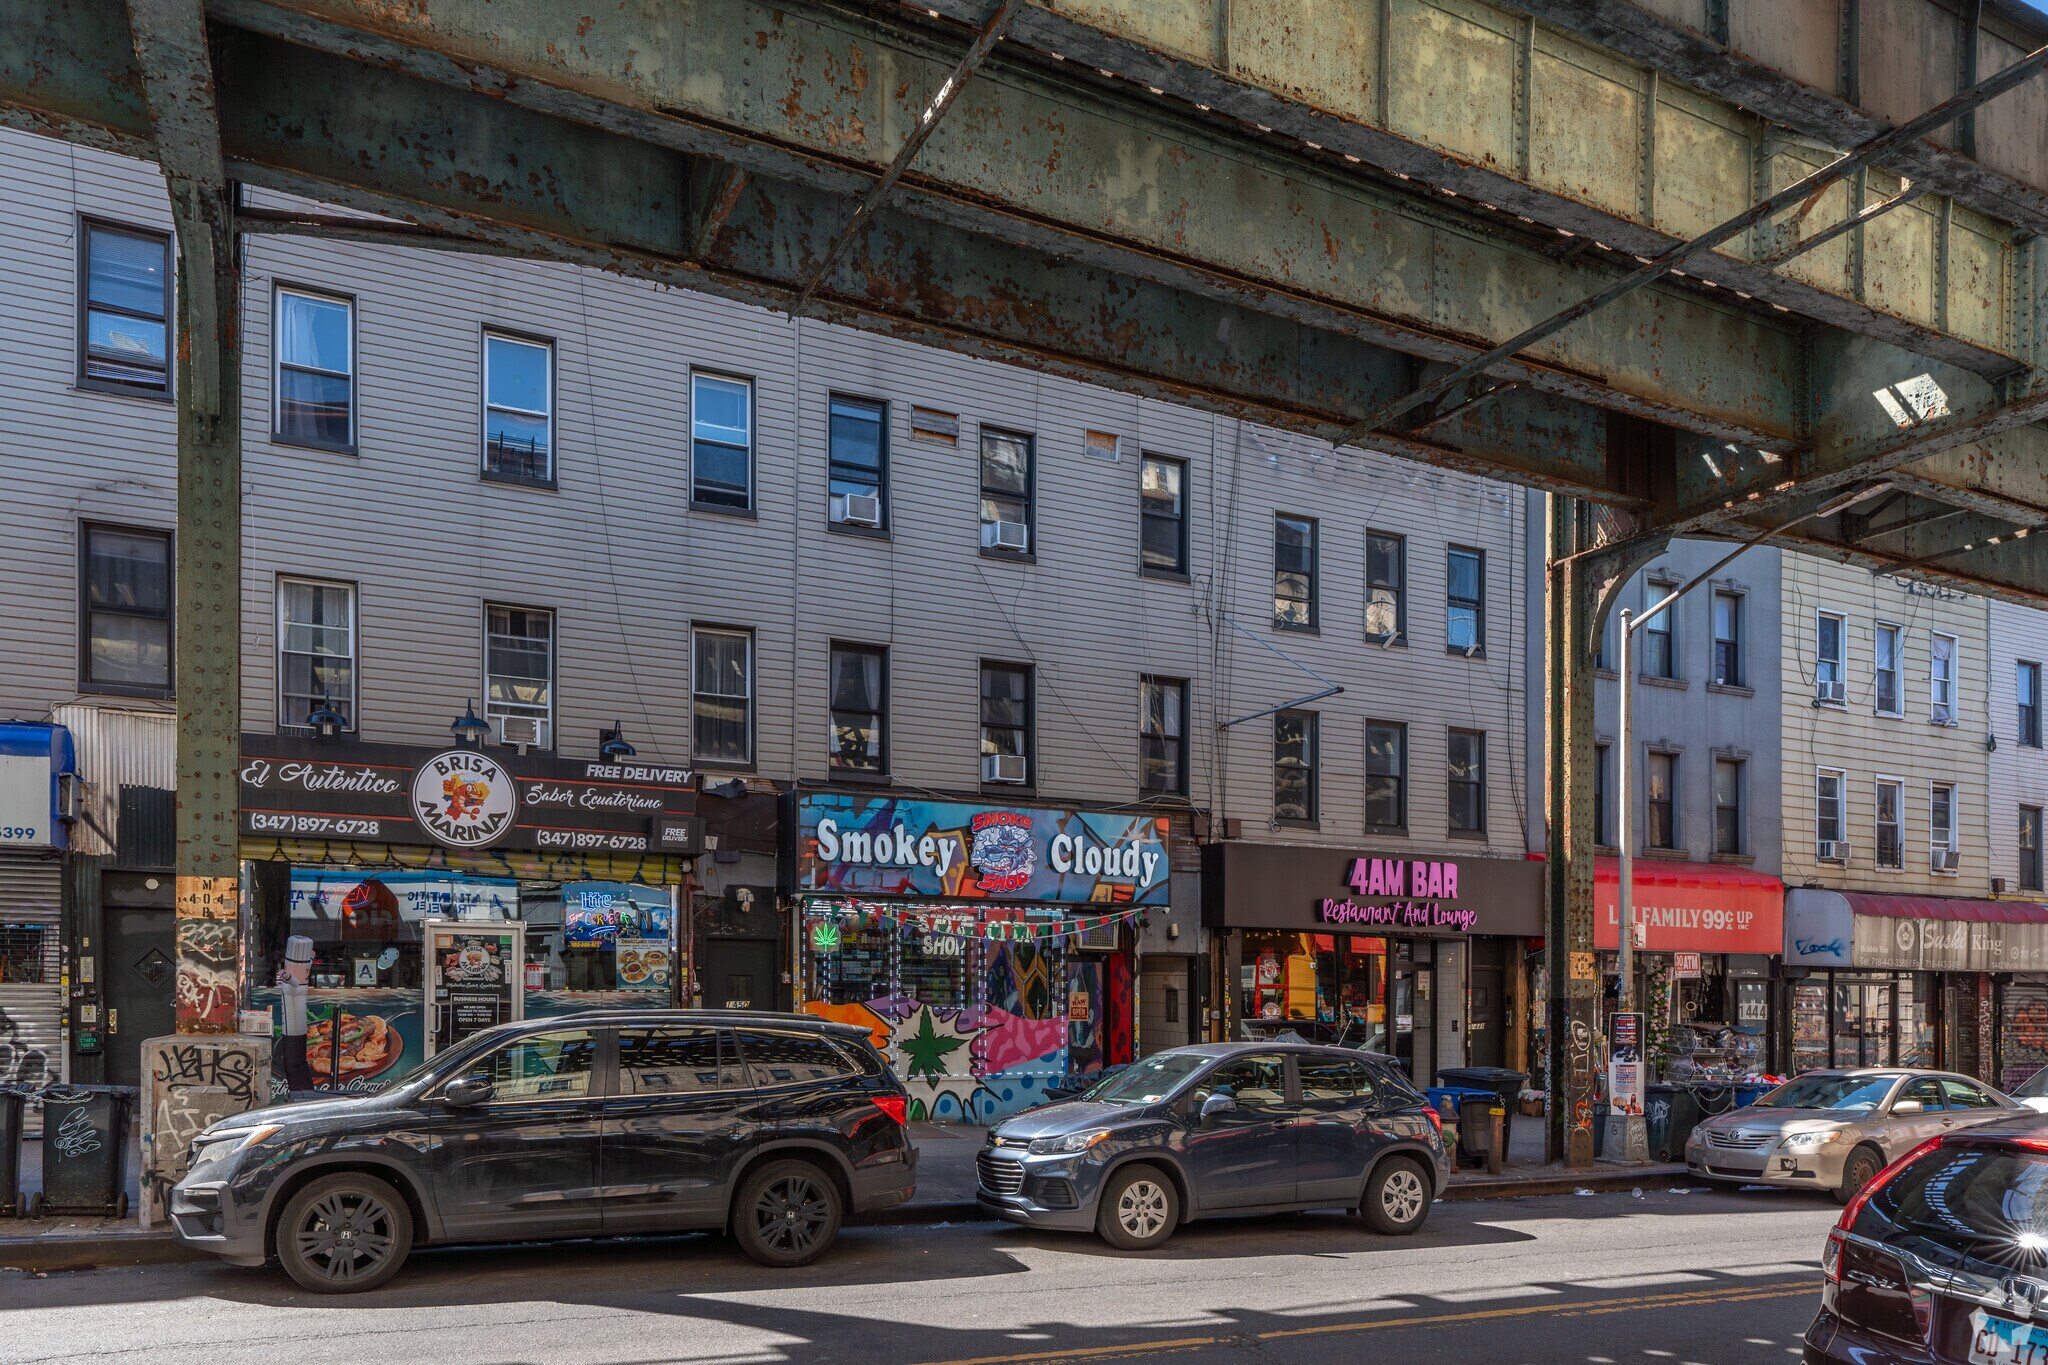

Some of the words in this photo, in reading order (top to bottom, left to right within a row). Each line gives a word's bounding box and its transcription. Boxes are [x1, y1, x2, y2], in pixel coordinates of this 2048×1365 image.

[241, 760, 271, 787] El
[432, 755, 497, 783] BRISA
[586, 764, 622, 779] FREE
[626, 767, 693, 784] DELIVERY
[526, 782, 574, 808] Sabor
[579, 788, 663, 812] Ecuatoriano
[251, 812, 380, 836] (347)897-6728
[420, 801, 508, 842] MARINA
[665, 827, 686, 836] FREE
[972, 812, 1033, 831] SMOKE
[536, 829, 647, 851] (347)897-6728
[662, 835, 689, 843] DELIVERY
[816, 818, 957, 877] Smokey
[1050, 833, 1160, 888] Cloudy
[202, 879, 212, 891] M
[978, 874, 1030, 891] SHOP
[1350, 858, 1404, 896] 4AM
[1412, 861, 1458, 898] BAR
[324, 885, 370, 901] OPEN
[580, 891, 612, 911] Lite
[1323, 897, 1402, 925] Restaurant
[1405, 901, 1429, 926] And
[1434, 902, 1478, 932] Lounge
[1642, 907, 1700, 929] FAMILY
[1702, 909, 1734, 930] 99¢
[1737, 911, 1753, 924] UP
[1972, 934, 2002, 956] King
[359, 964, 372, 978] A
[461, 961, 489, 973] MARINA
[1683, 955, 1698, 970] ATM
[1073, 1008, 1086, 1016] OPEN
[1739, 1004, 1766, 1018] 1444
